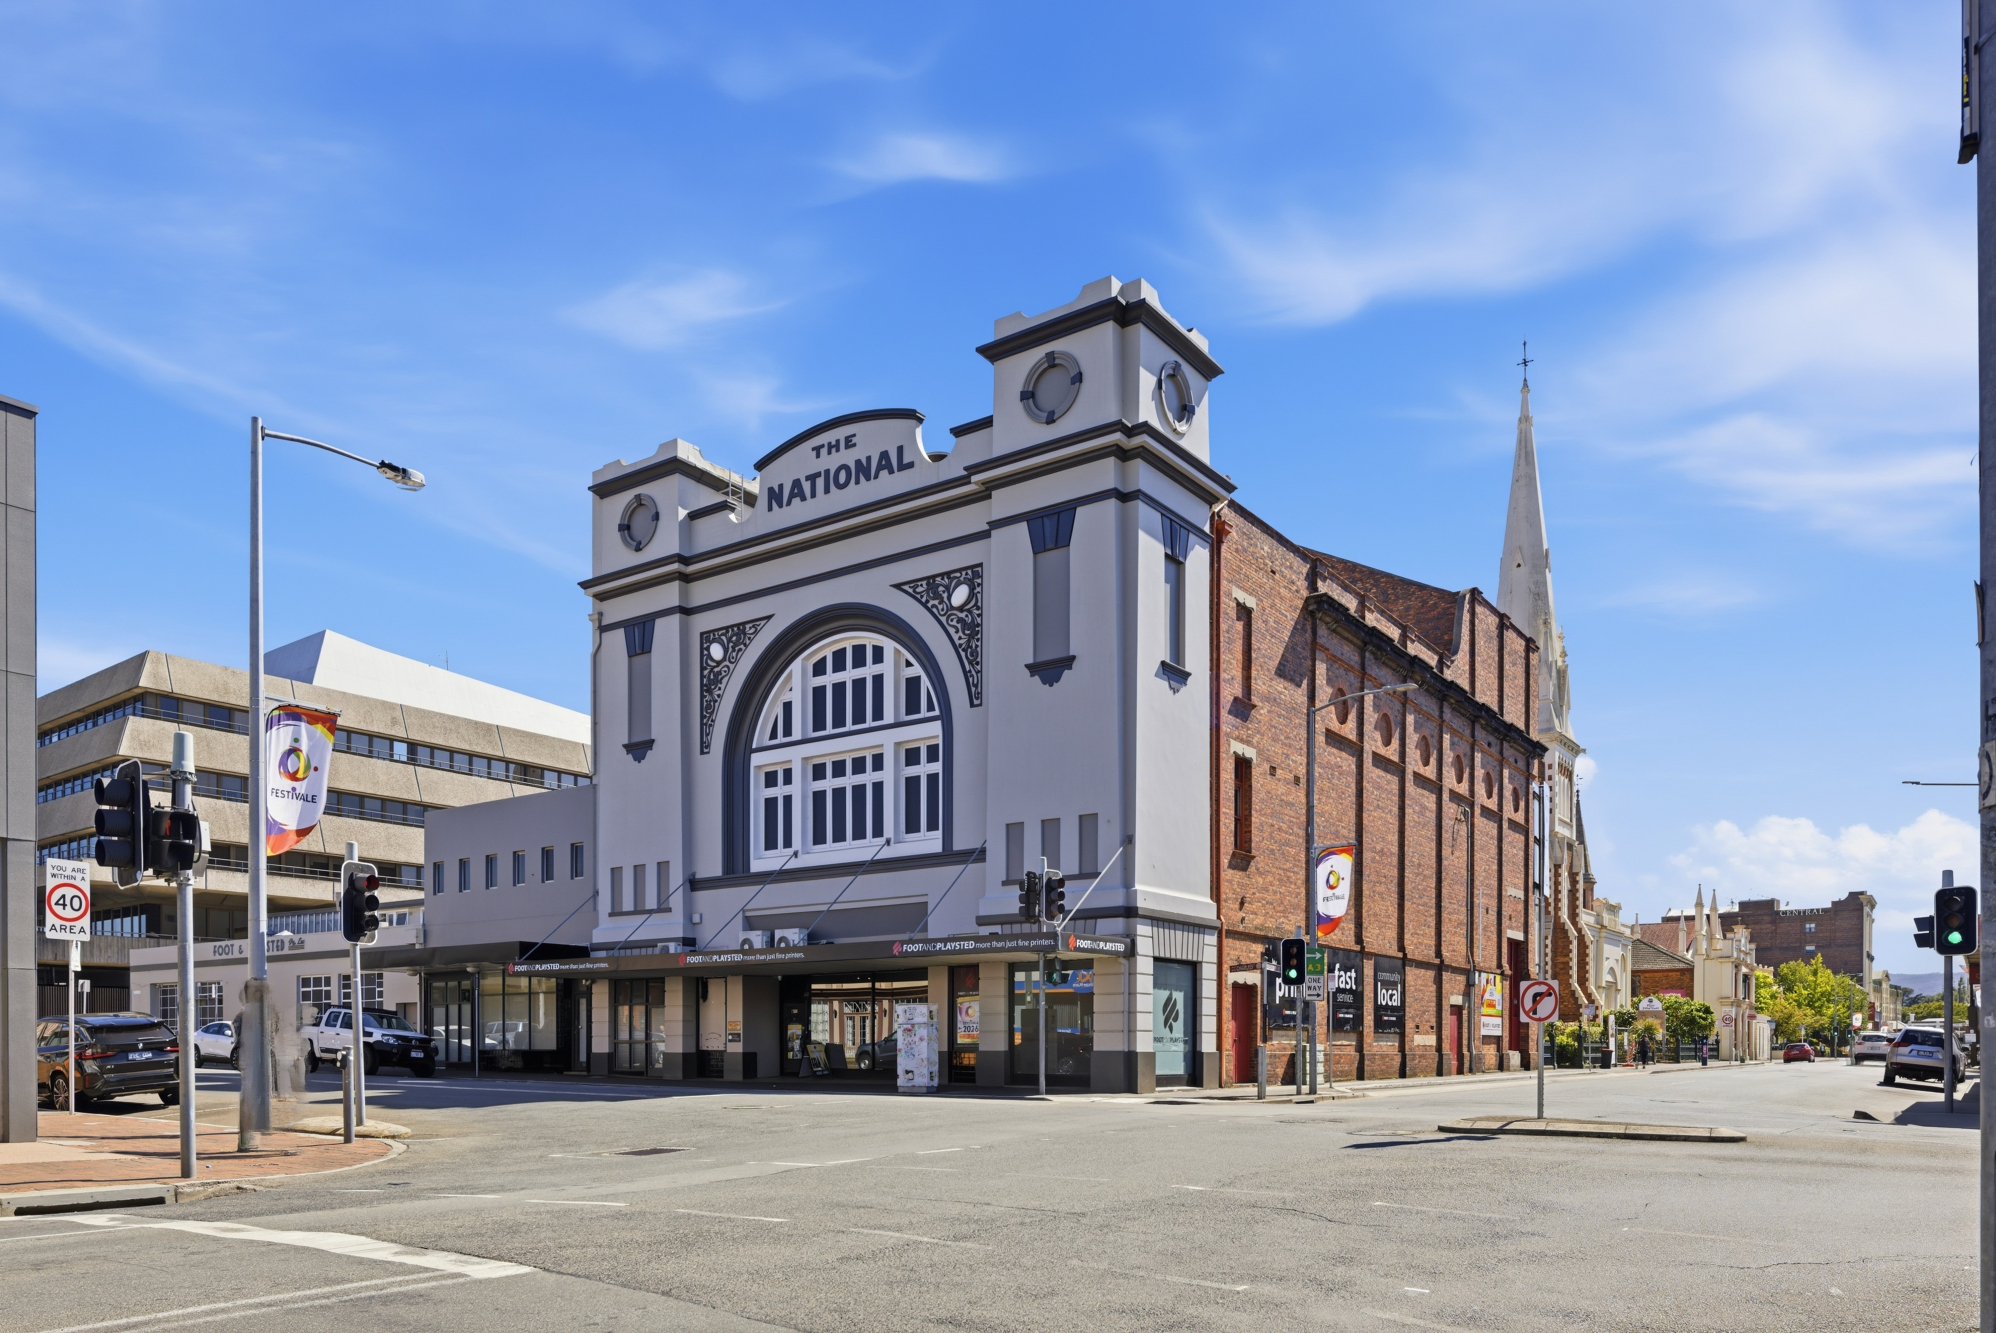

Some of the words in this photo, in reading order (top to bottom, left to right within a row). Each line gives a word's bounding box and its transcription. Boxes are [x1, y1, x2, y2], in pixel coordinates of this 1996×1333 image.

[811, 433, 857, 459] THE
[767, 445, 915, 512] NATIONAL
[271, 787, 318, 803] FESTIVALE
[51, 864, 67, 872] YOU
[51, 872, 76, 881] WITHIN
[54, 893, 82, 912] 40
[1780, 908, 1824, 916] CENTRAL
[49, 923, 86, 935] AREA
[991, 940, 1005, 948] than
[1005, 939, 1017, 948] just
[1017, 938, 1029, 946] fine
[213, 943, 234, 956] FOOT
[238, 944, 244, 955] &
[766, 953, 775, 961] just
[1335, 963, 1356, 990] fast
[1378, 972, 1400, 984] community
[1337, 992, 1353, 1002] service
[1378, 981, 1400, 1006] local
[963, 1025, 979, 1033] 2026
